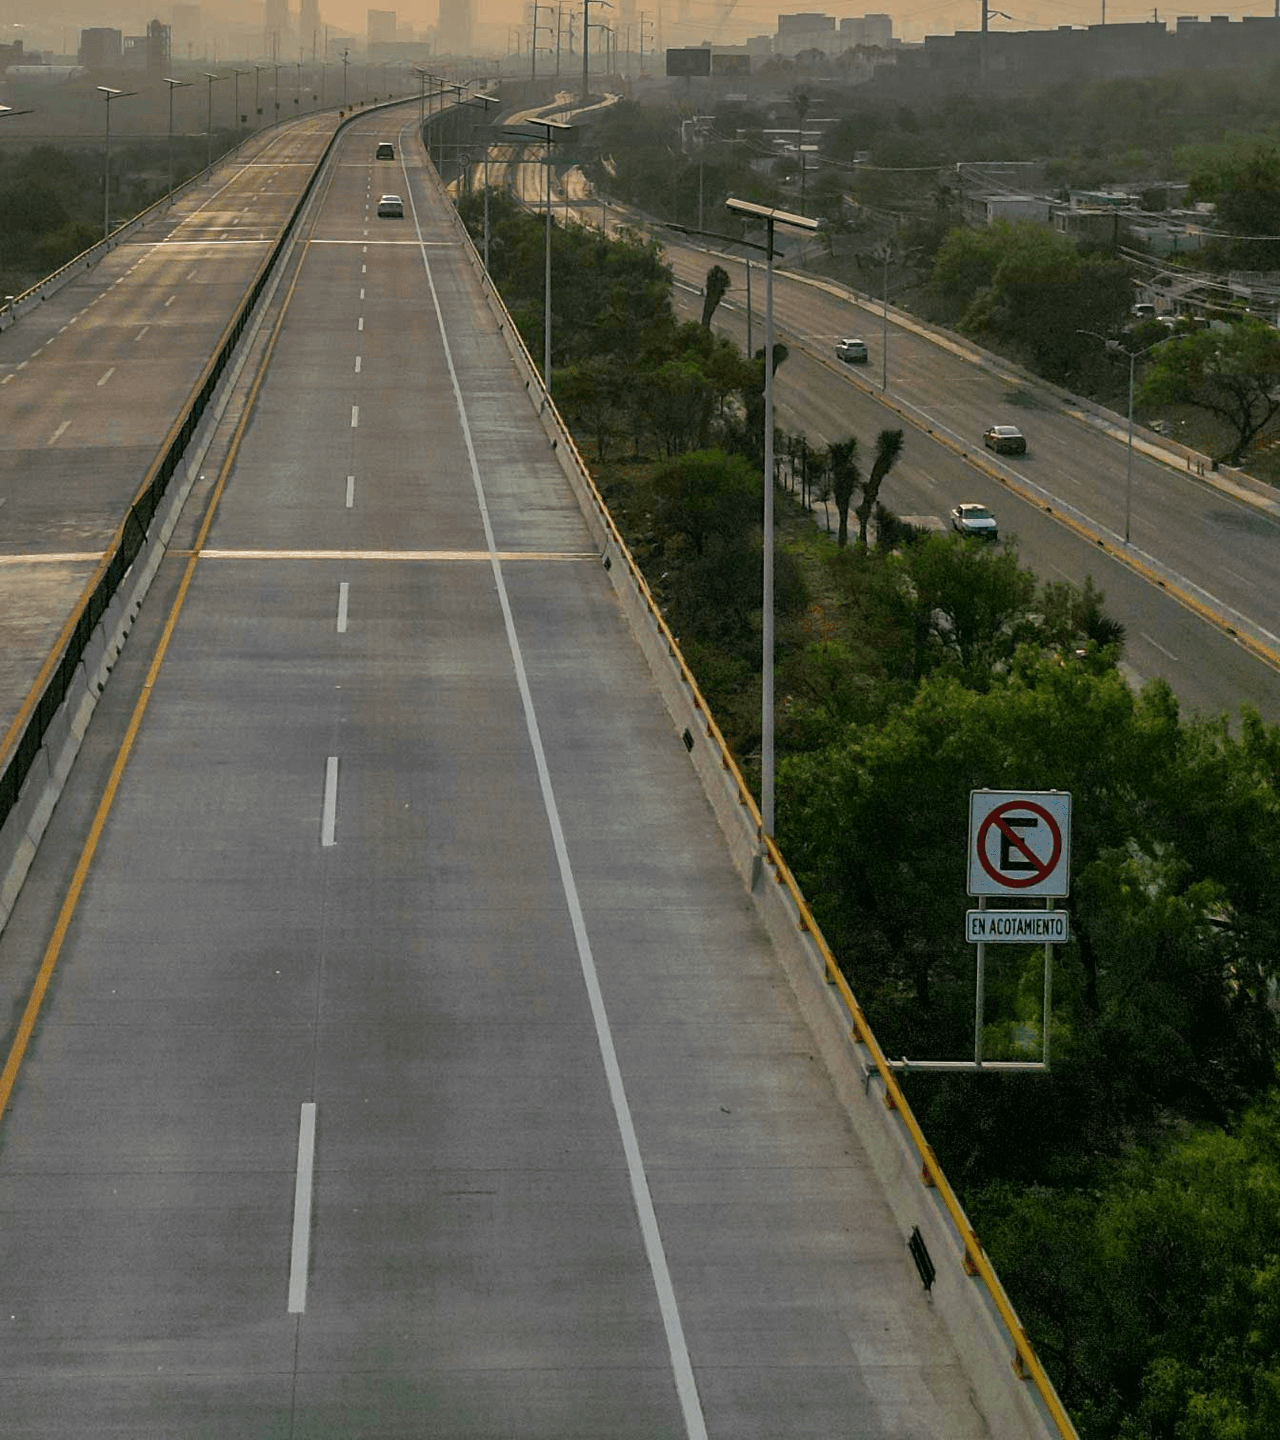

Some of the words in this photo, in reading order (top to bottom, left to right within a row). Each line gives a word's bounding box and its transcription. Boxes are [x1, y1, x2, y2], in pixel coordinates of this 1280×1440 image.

[1000, 817, 1040, 871] E
[972, 918, 985, 935] EN
[989, 918, 1063, 936] ACOTAMIENTO
